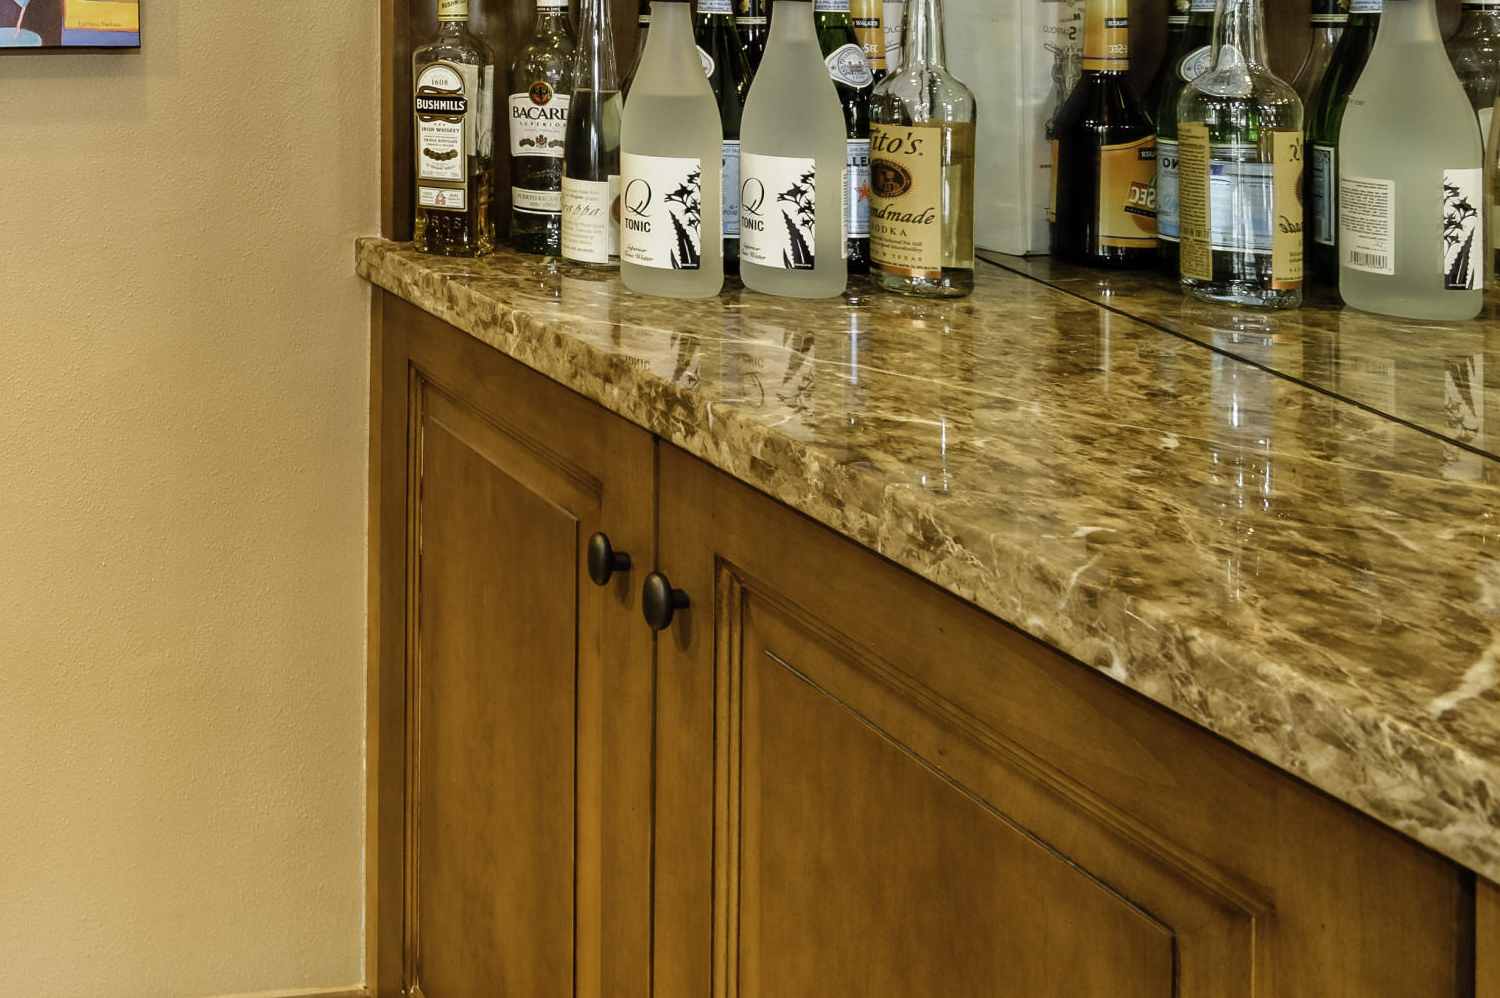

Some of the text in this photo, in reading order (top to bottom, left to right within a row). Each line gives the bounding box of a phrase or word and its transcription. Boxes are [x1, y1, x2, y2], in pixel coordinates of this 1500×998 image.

[416, 98, 465, 111] BUSHMILLS
[625, 179, 651, 217] Q
[742, 178, 764, 216] Q
[625, 218, 651, 233] TONIC
[742, 216, 764, 232] TONIC
